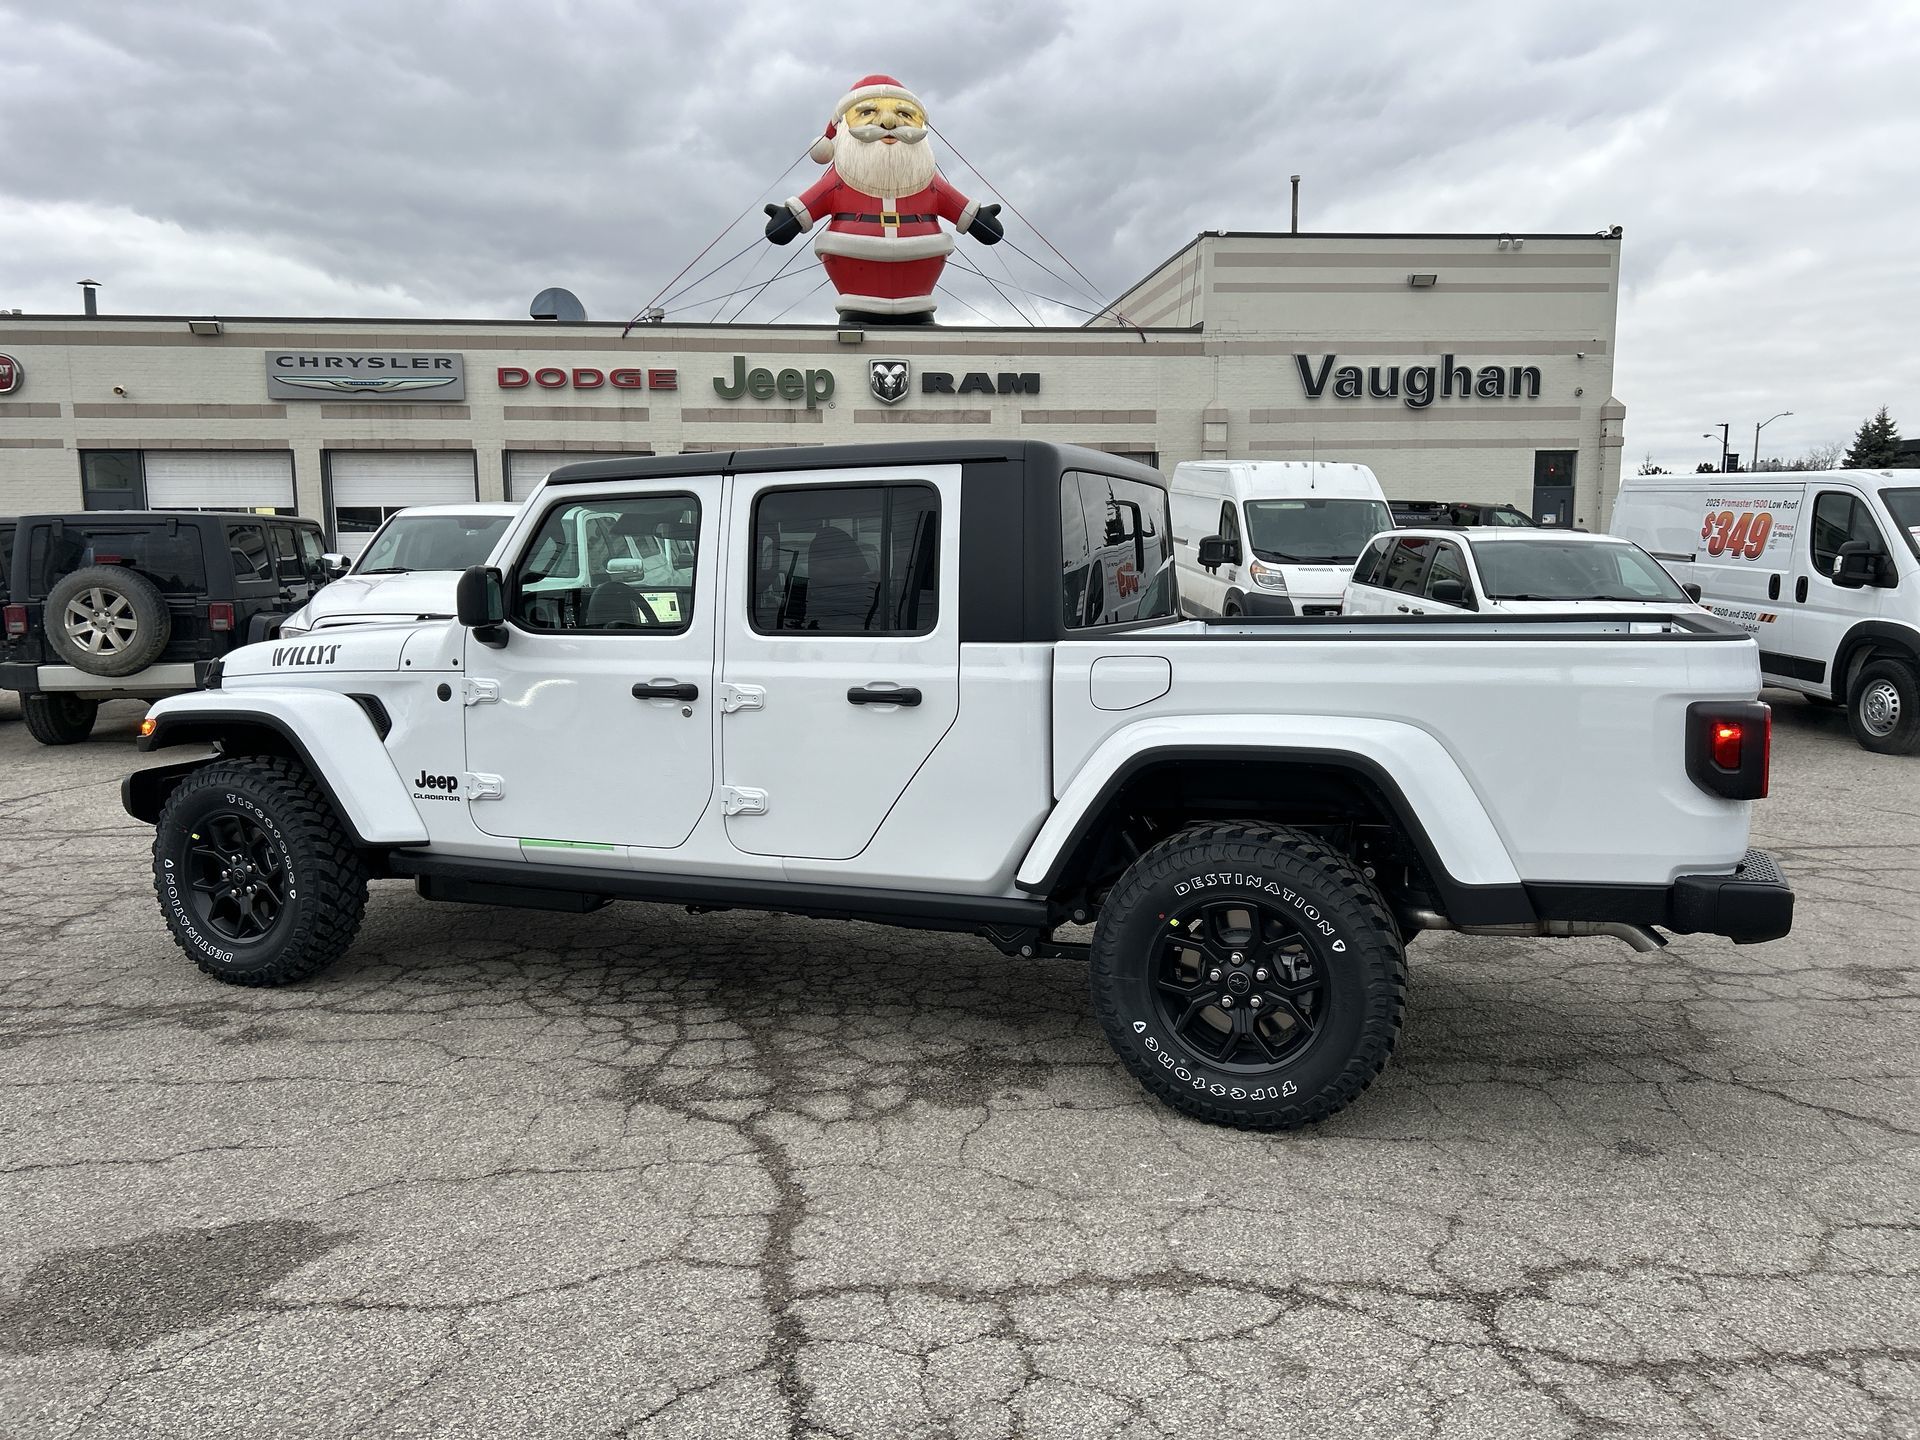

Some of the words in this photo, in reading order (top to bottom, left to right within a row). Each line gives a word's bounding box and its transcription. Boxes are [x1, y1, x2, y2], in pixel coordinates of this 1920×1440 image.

[275, 356, 453, 369] CHRYSLER
[497, 367, 678, 390] DODGE
[712, 355, 836, 410] Jeep
[921, 371, 1041, 395] RAM
[1294, 352, 1542, 409] Vaughan
[1705, 499, 1720, 507] 2025
[1720, 499, 1752, 508] Promaster
[1752, 499, 1769, 509] 1500
[1768, 501, 1781, 509] Low
[1782, 500, 1799, 510] Roof
[1701, 511, 1773, 560] $349
[1713, 608, 1728, 617] 2500
[1728, 611, 1740, 619] and
[1740, 611, 1757, 620] 3500
[272, 644, 342, 667] WILLYS
[414, 770, 458, 793] Jeep
[413, 793, 461, 802] GLADIATOR
[1174, 872, 1335, 937] DESTINATION
[165, 873, 234, 963] DESTINATION
